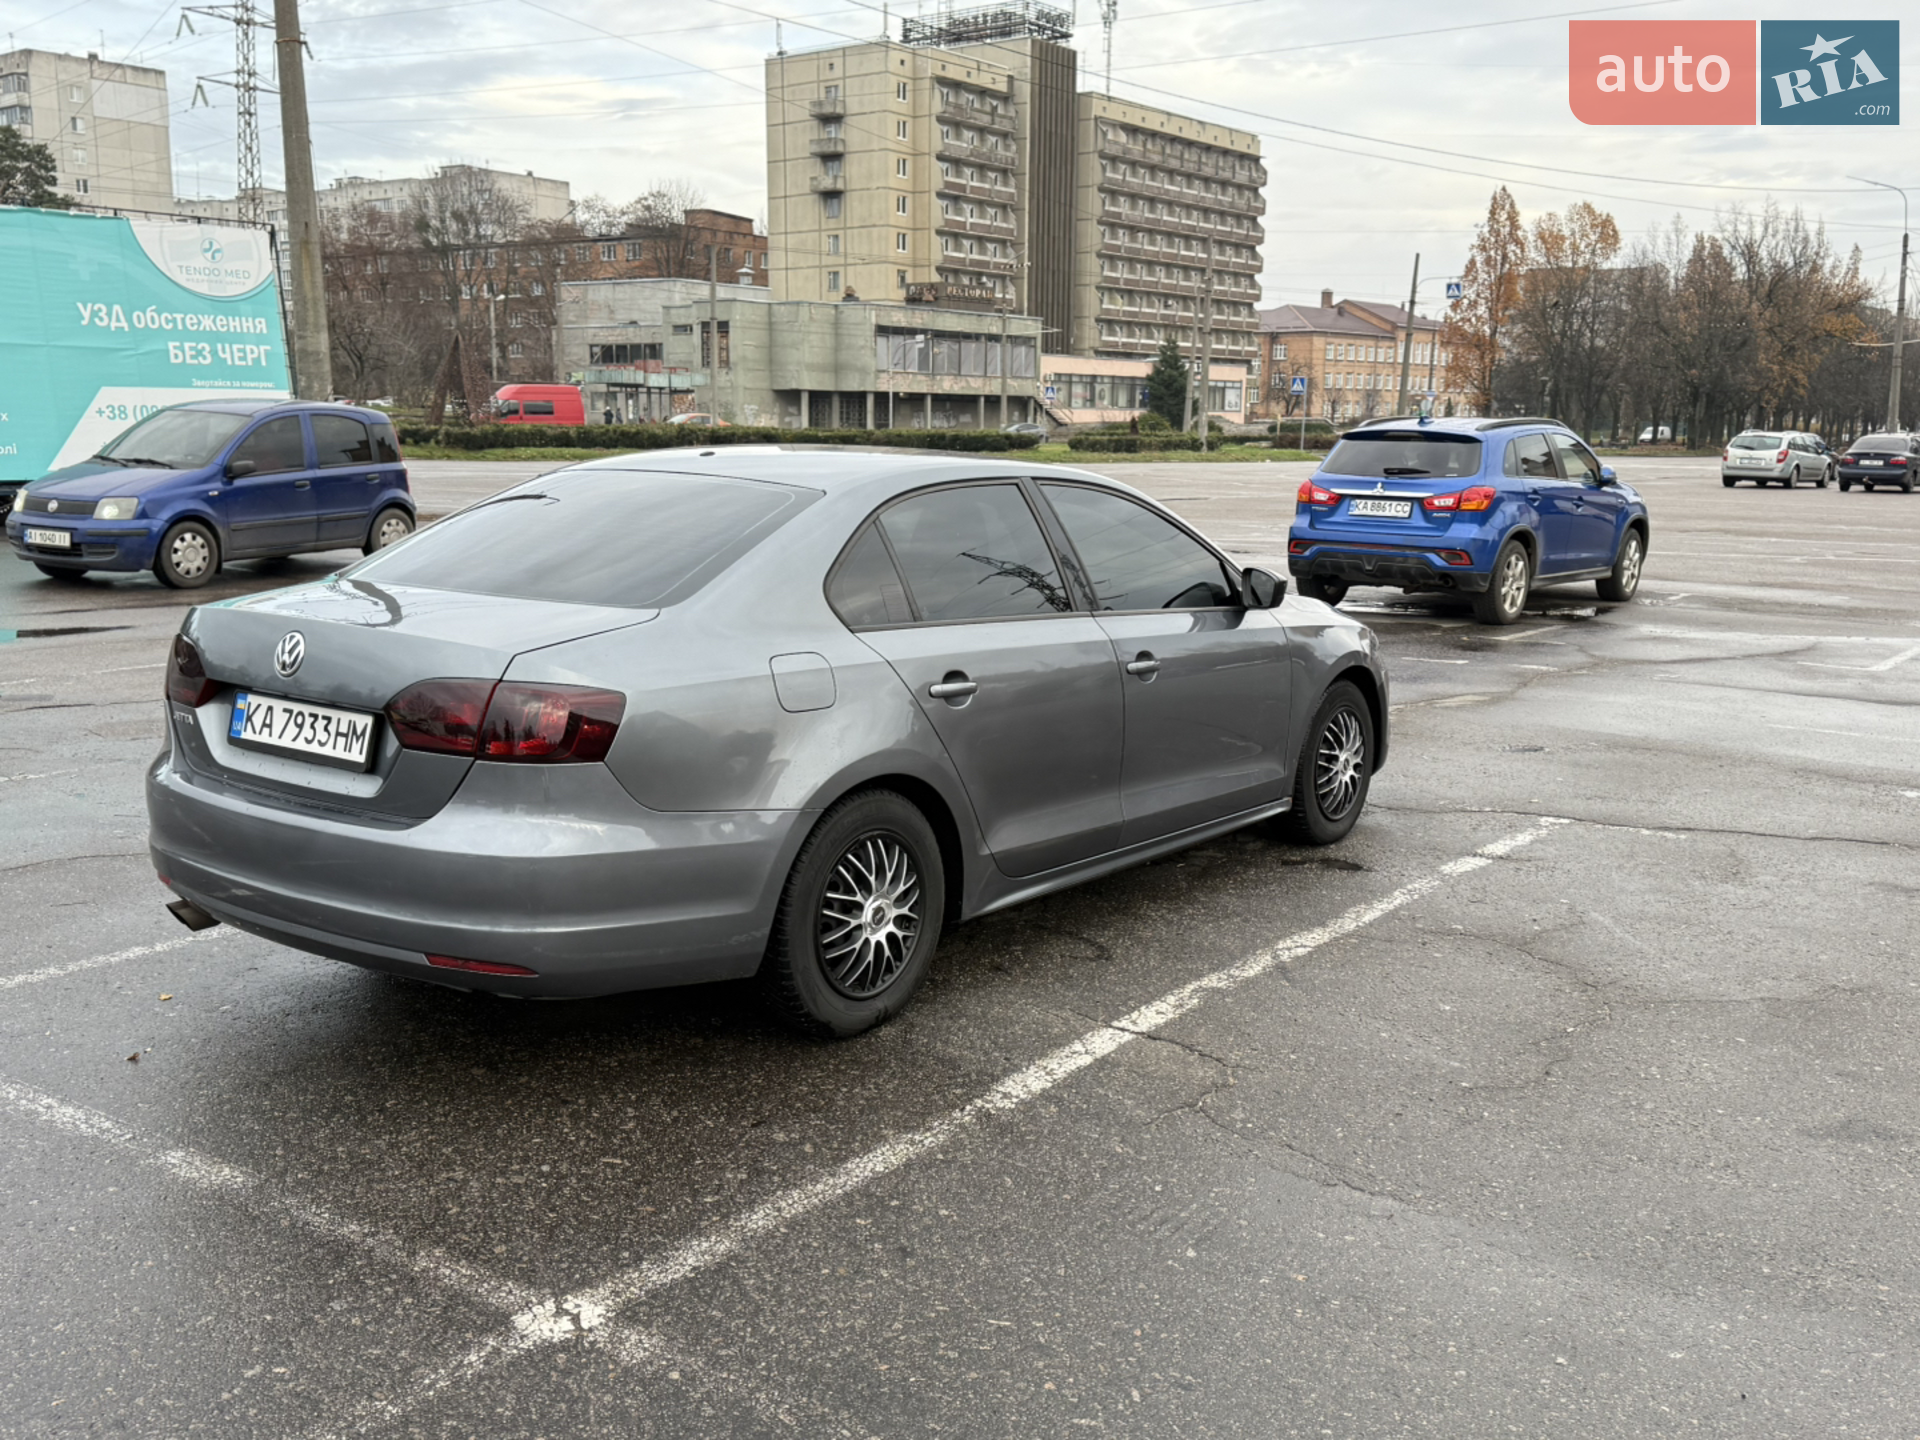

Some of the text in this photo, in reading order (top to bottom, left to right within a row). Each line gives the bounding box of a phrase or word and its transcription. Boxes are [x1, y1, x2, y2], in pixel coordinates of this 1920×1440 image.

[177, 265, 251, 280] TENDO MED
[76, 302, 268, 334] УЗД обстеження
[167, 341, 271, 366] БЕЗ ЧЕРГ
[95, 404, 129, 421] +38
[243, 701, 369, 756] KA 7933 HM
